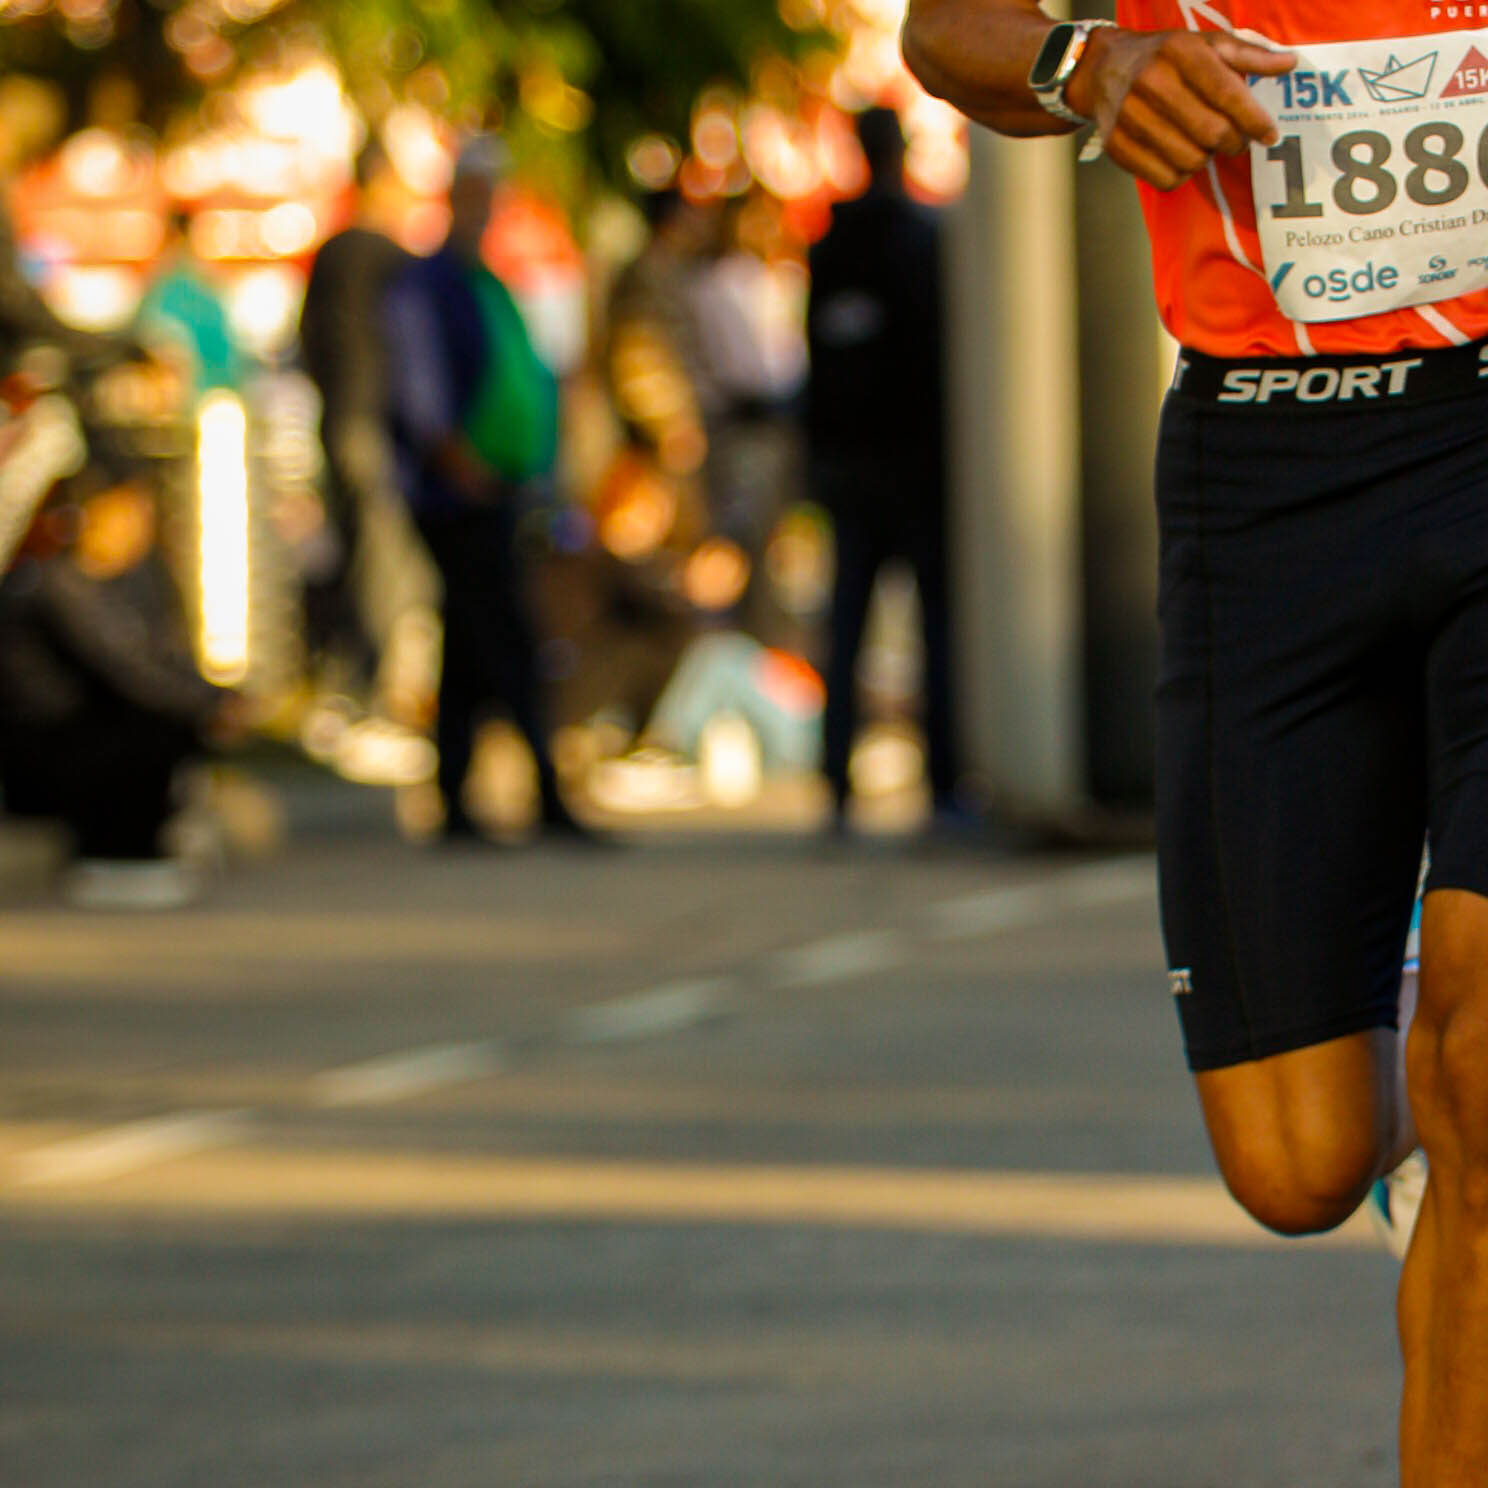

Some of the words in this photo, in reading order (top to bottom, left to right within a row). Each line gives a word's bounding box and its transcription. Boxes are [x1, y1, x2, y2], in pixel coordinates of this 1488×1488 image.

[1276, 69, 1353, 109] 15K
[1286, 230, 1344, 247] Pelozo
[1350, 225, 1394, 242] Cano
[1399, 213, 1466, 236] Cristian
[1303, 261, 1399, 301] osde
[1218, 358, 1423, 404] SPORT
